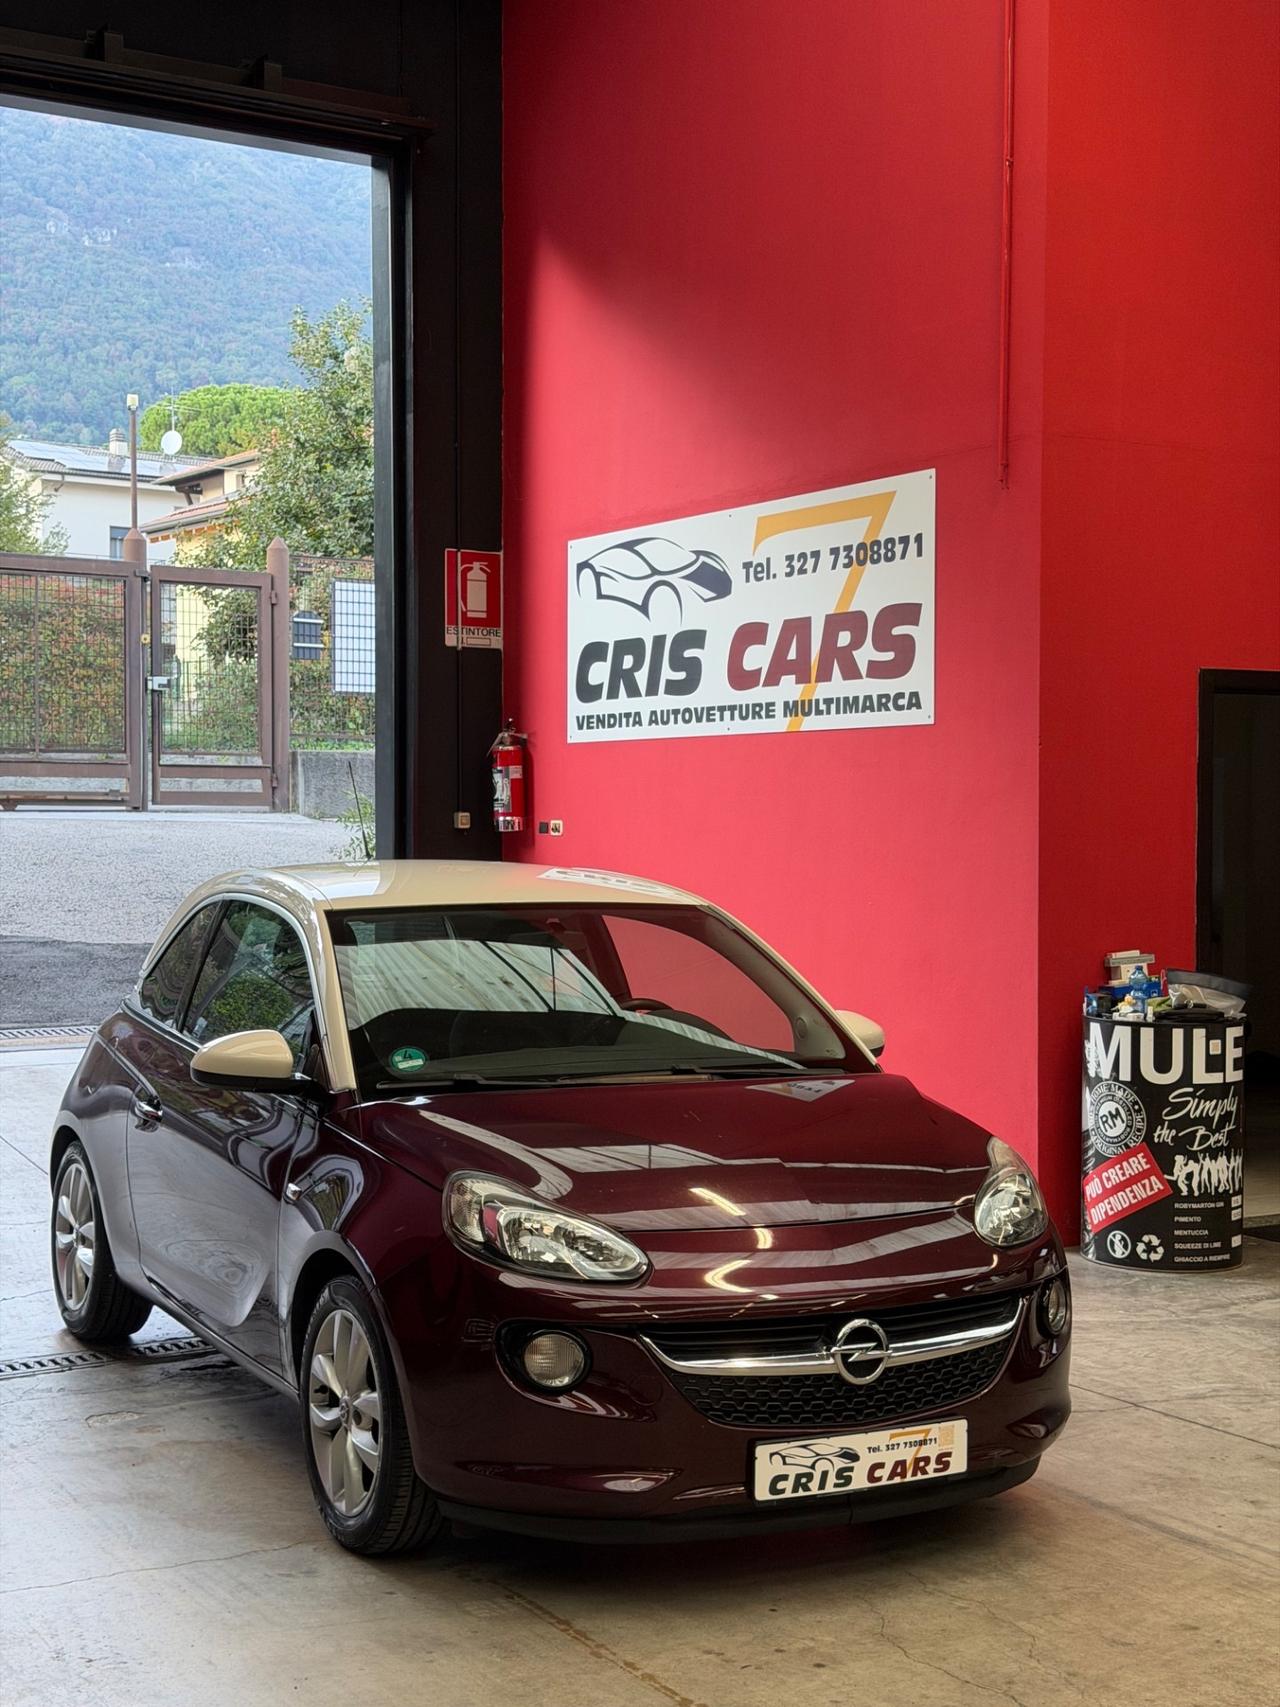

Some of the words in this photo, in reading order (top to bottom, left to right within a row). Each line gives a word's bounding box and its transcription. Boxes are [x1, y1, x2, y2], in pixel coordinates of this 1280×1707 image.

[741, 560, 777, 584] Tel.
[784, 550, 821, 577] 327
[829, 532, 924, 571] 7308871
[447, 627, 502, 638] ESTINTORE
[575, 629, 707, 704] CRIS
[726, 602, 923, 692] CARS
[575, 711, 643, 731] VENDITA
[648, 701, 776, 727] AUTOVETTURE
[782, 690, 923, 718] MULTIMARCA
[1089, 1021, 1244, 1085] MULE
[1111, 1083, 1136, 1106] MADE
[1162, 1085, 1239, 1129] Simply
[1100, 1106, 1125, 1133] RM
[1127, 1111, 1145, 1148] RECIPE
[1153, 1121, 1176, 1146] the
[1178, 1122, 1236, 1151] Best
[1085, 1174, 1103, 1202] PUÒ
[1102, 1152, 1151, 1189] CREARE
[1090, 1175, 1165, 1225] DIPENDENZA
[867, 1446, 882, 1454] Tel.
[885, 1443, 901, 1452] 327
[768, 1466, 854, 1496] CRIS
[867, 1451, 953, 1484] CARS
